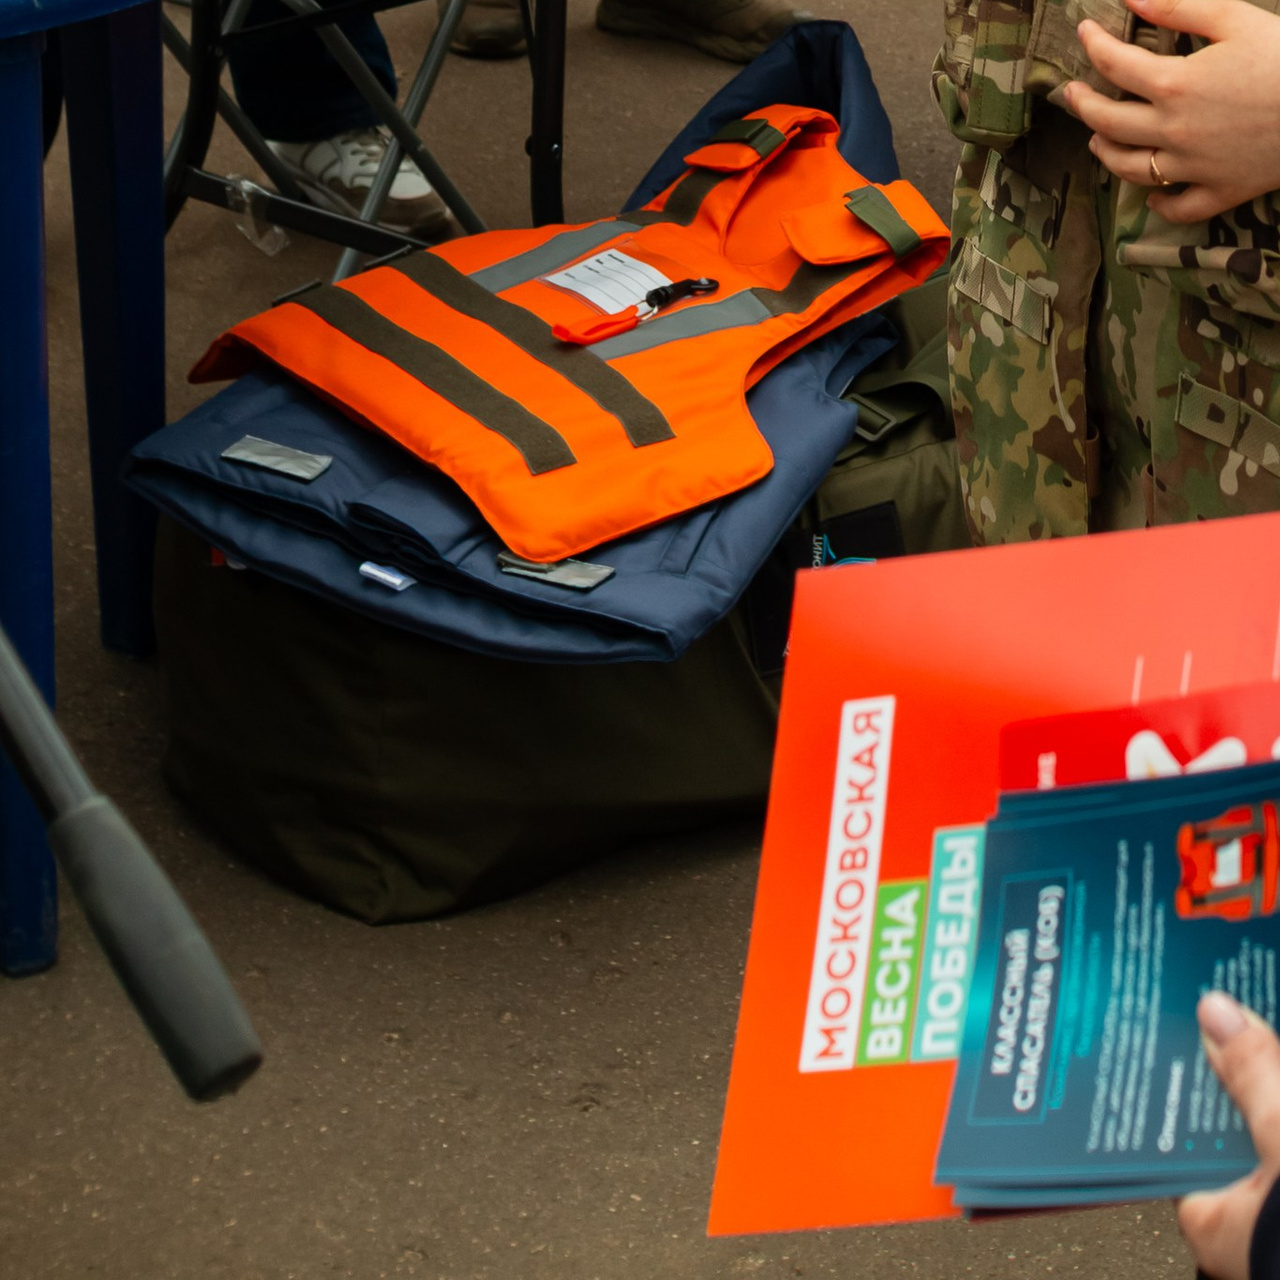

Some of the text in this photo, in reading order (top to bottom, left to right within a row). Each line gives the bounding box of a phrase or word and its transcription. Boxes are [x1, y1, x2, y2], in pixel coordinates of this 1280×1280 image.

[814, 708, 883, 1062] МОСКОВСКАЯ
[920, 834, 979, 1055] ПОБЕДЫ
[866, 886, 921, 1060] ВЕСНА
[990, 928, 1031, 1075] КЛАССНЫЙ
[1012, 962, 1054, 1112] СПАСАТЕЛЬ
